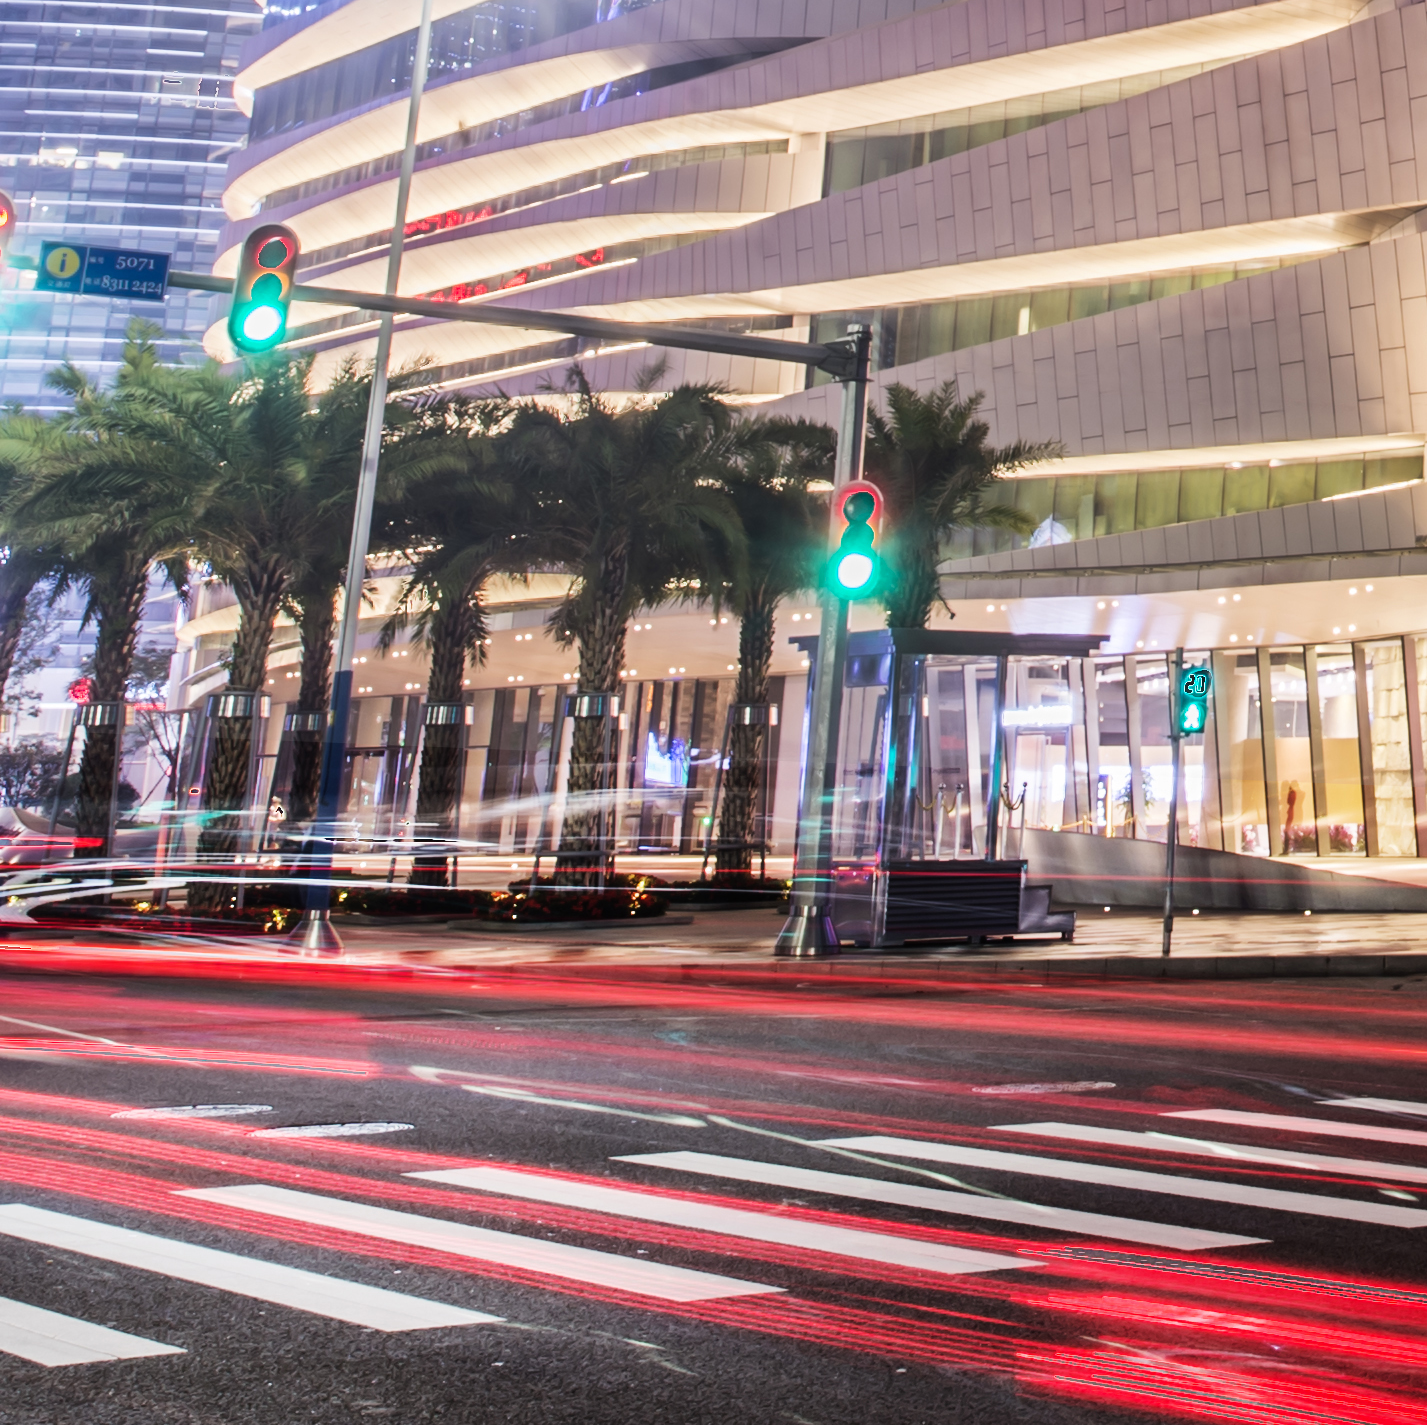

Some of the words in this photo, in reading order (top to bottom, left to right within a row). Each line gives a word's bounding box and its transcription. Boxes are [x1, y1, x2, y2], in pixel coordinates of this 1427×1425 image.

[115, 255, 155, 271] 5071
[101, 274, 129, 292] 8311
[131, 279, 163, 295] 2424
